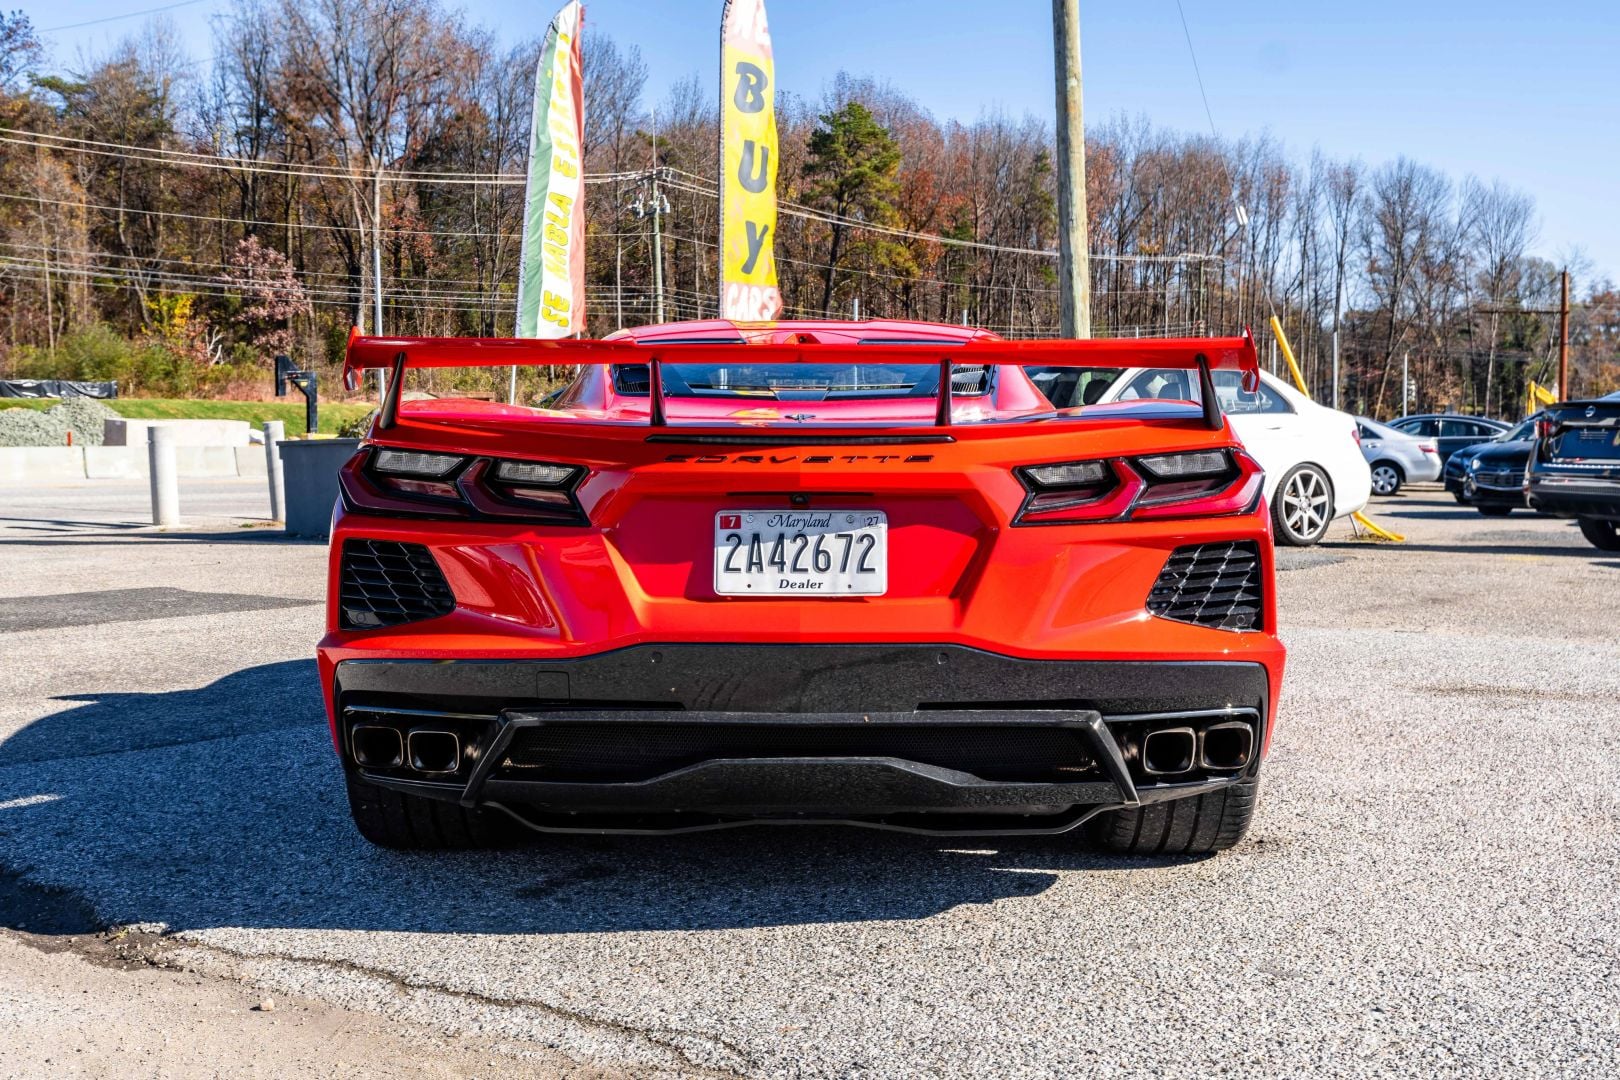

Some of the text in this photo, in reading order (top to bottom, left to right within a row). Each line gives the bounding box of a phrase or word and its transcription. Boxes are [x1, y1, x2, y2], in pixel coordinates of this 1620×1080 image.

[733, 61, 769, 275] BUY
[543, 191, 573, 283] HABLA
[541, 289, 570, 328] SE
[726, 283, 777, 321] CARS
[663, 454, 935, 464] CORVETTE
[728, 516, 737, 528] 7
[766, 513, 832, 532] Maryland
[867, 516, 879, 526] 27
[723, 533, 877, 574] 2A42672
[778, 578, 824, 590] Dealer
